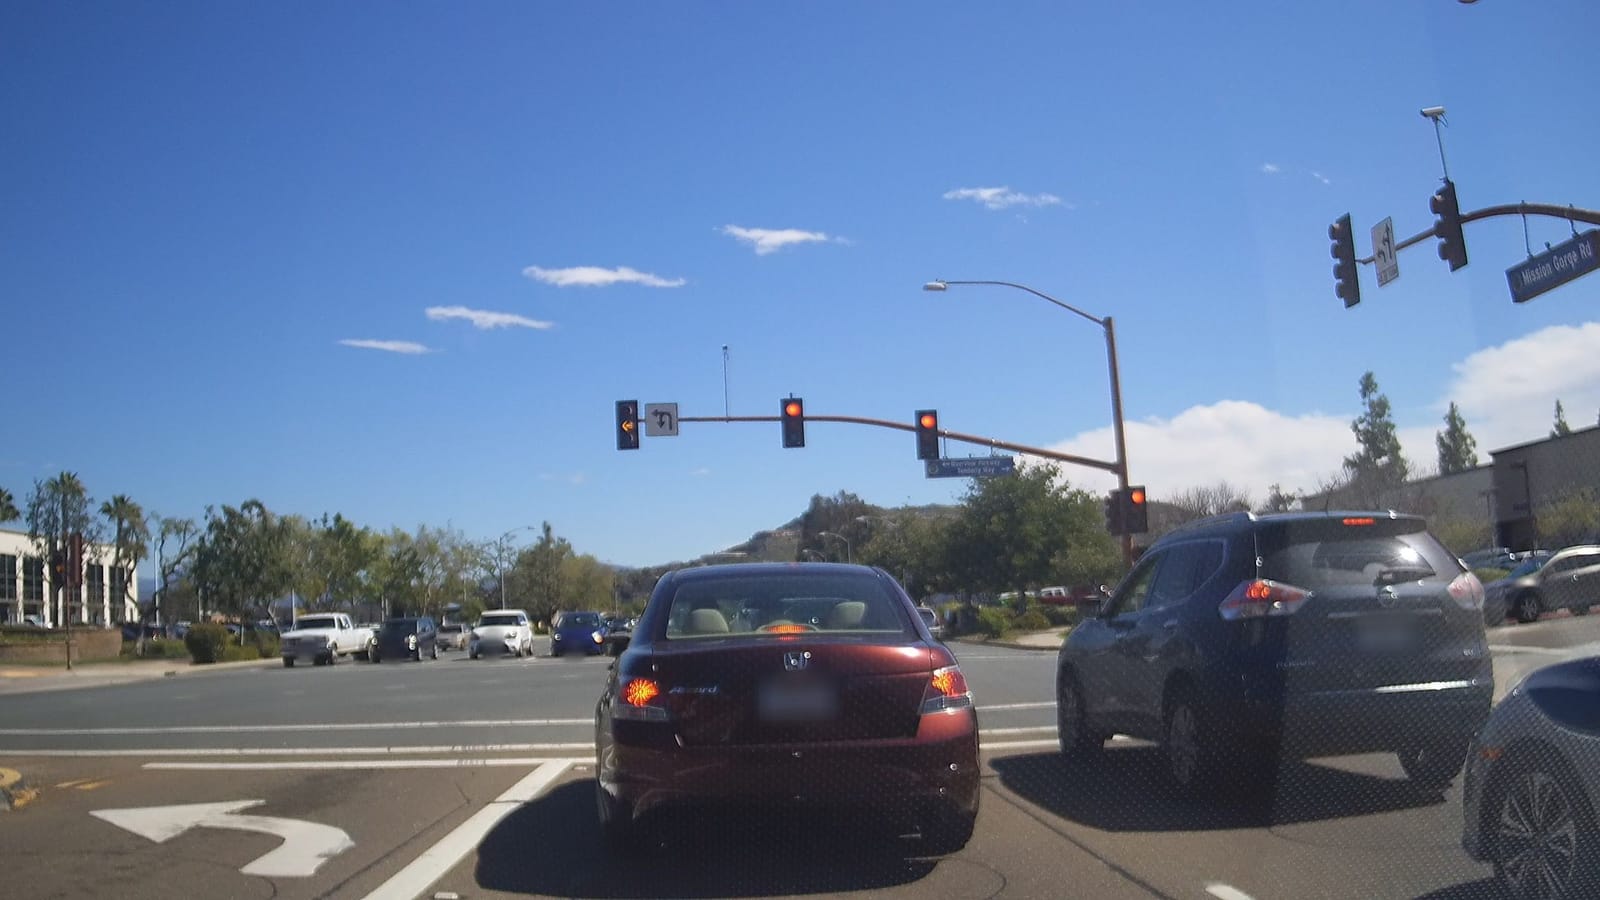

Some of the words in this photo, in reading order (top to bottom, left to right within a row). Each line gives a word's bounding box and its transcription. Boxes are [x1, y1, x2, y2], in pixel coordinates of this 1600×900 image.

[1521, 263, 1552, 286] Mission
[1552, 250, 1578, 271] Gorge
[1579, 239, 1592, 259] Rd
